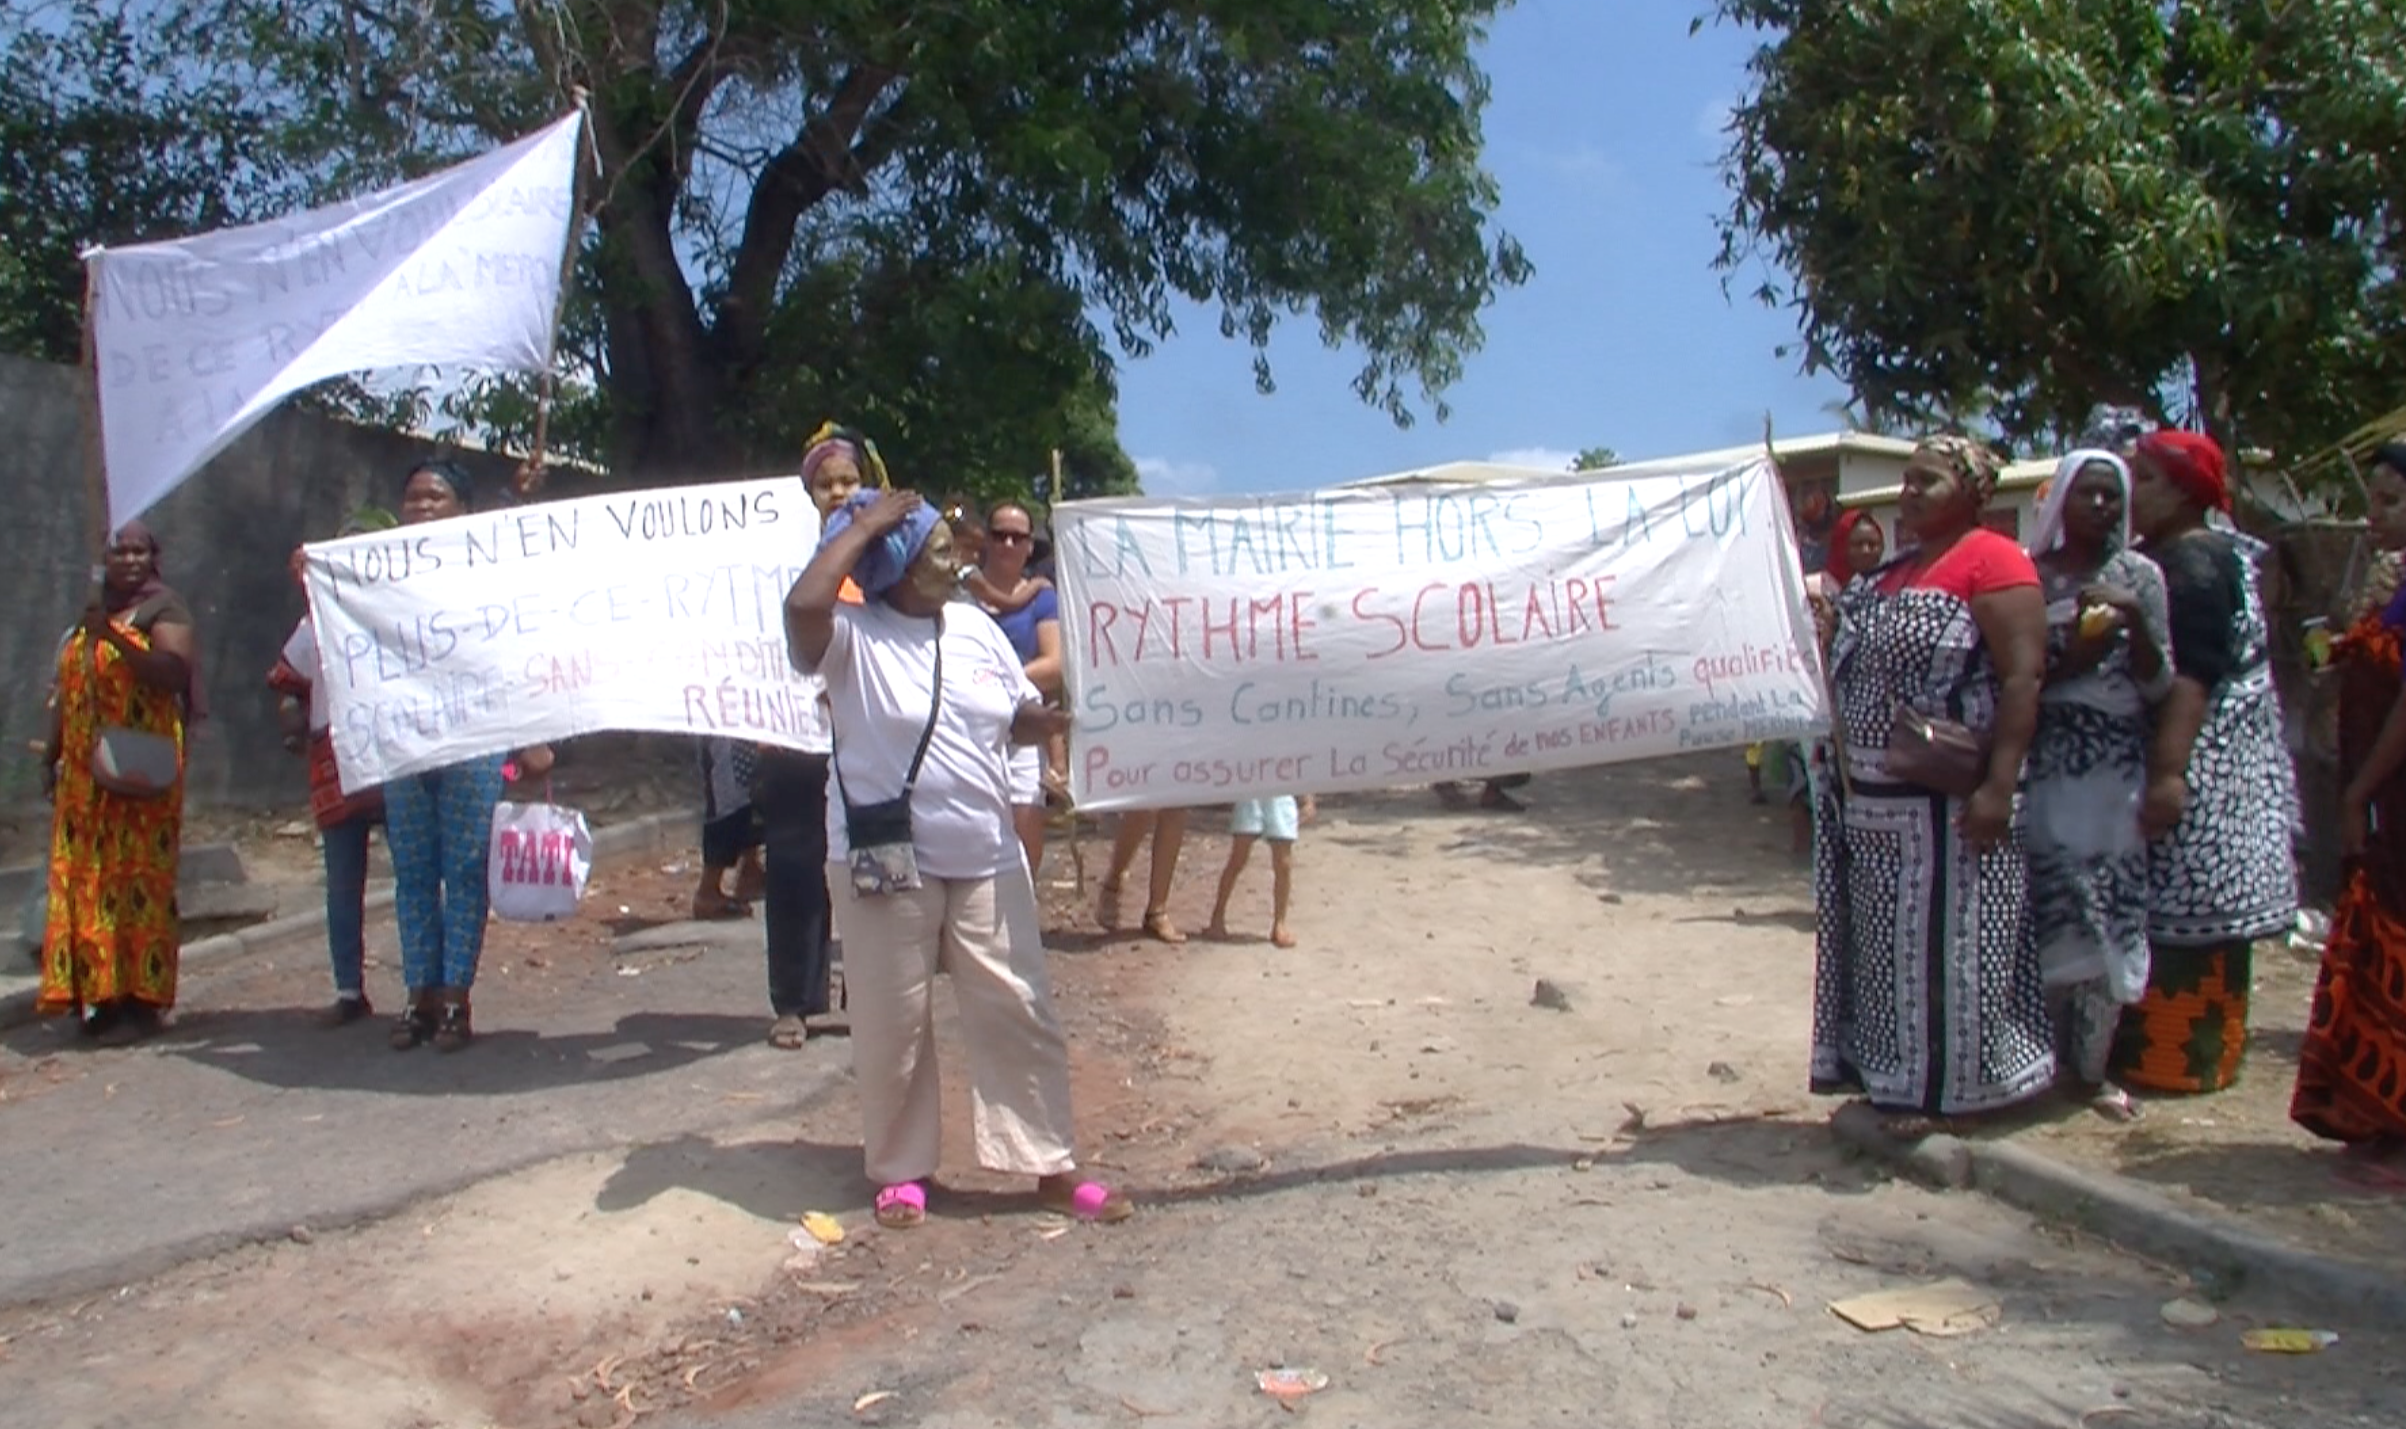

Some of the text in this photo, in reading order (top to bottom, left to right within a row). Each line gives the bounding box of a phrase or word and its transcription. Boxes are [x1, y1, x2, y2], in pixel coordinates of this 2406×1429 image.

[108, 342, 170, 388] DE
[329, 491, 779, 599] NOUS N'EN VOULONS
[1078, 514, 1152, 579] LA
[1174, 498, 1355, 576] MAIRIE
[1394, 492, 1543, 564] HORS
[1586, 484, 1651, 547] LA
[1087, 568, 1620, 668] RYTHME SCOLAIRE
[1079, 685, 1204, 733] Sans
[1445, 672, 1547, 718] Sans
[1563, 649, 1690, 718] Agents
[1085, 709, 1676, 794] Pour assurer La Sécurité de nos ENFANTS
[499, 828, 575, 888] TATI
